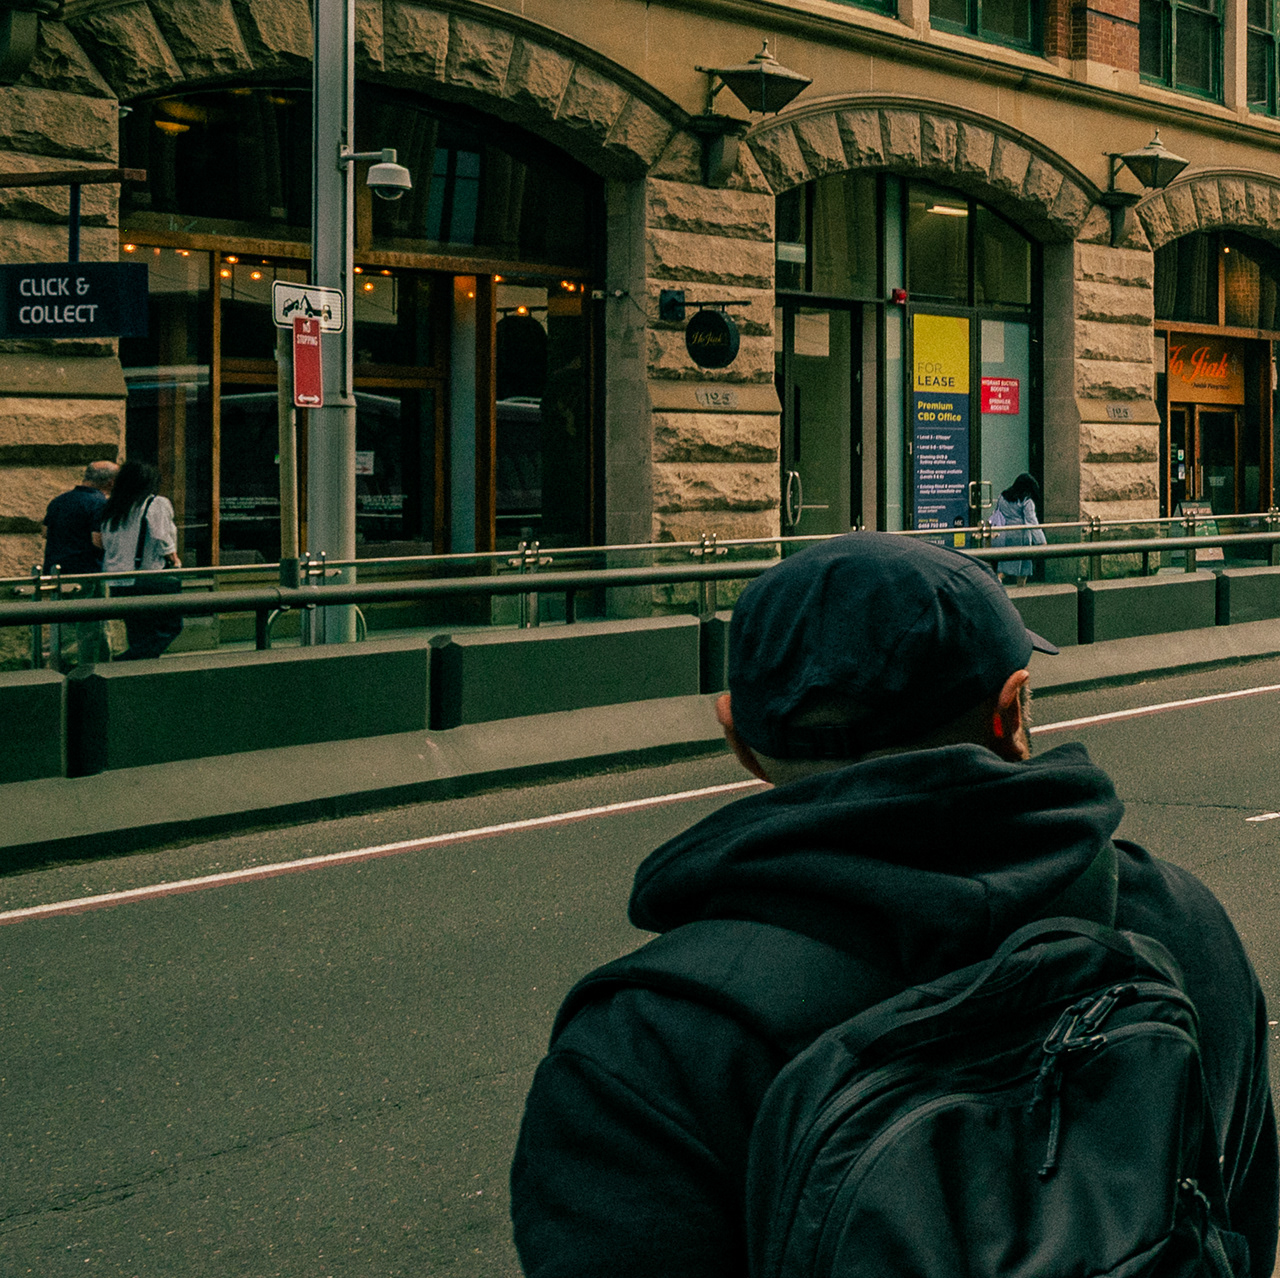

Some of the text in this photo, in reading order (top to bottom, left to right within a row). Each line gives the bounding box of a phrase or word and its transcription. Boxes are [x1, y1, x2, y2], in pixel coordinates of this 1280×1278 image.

[20, 277, 90, 296] CLICK &
[19, 304, 98, 323] COLLECT
[917, 362, 943, 374] FOR
[917, 376, 955, 387] LEASE
[705, 391, 731, 406] 125
[917, 401, 954, 410] Premium
[917, 412, 962, 422] CBD Office
